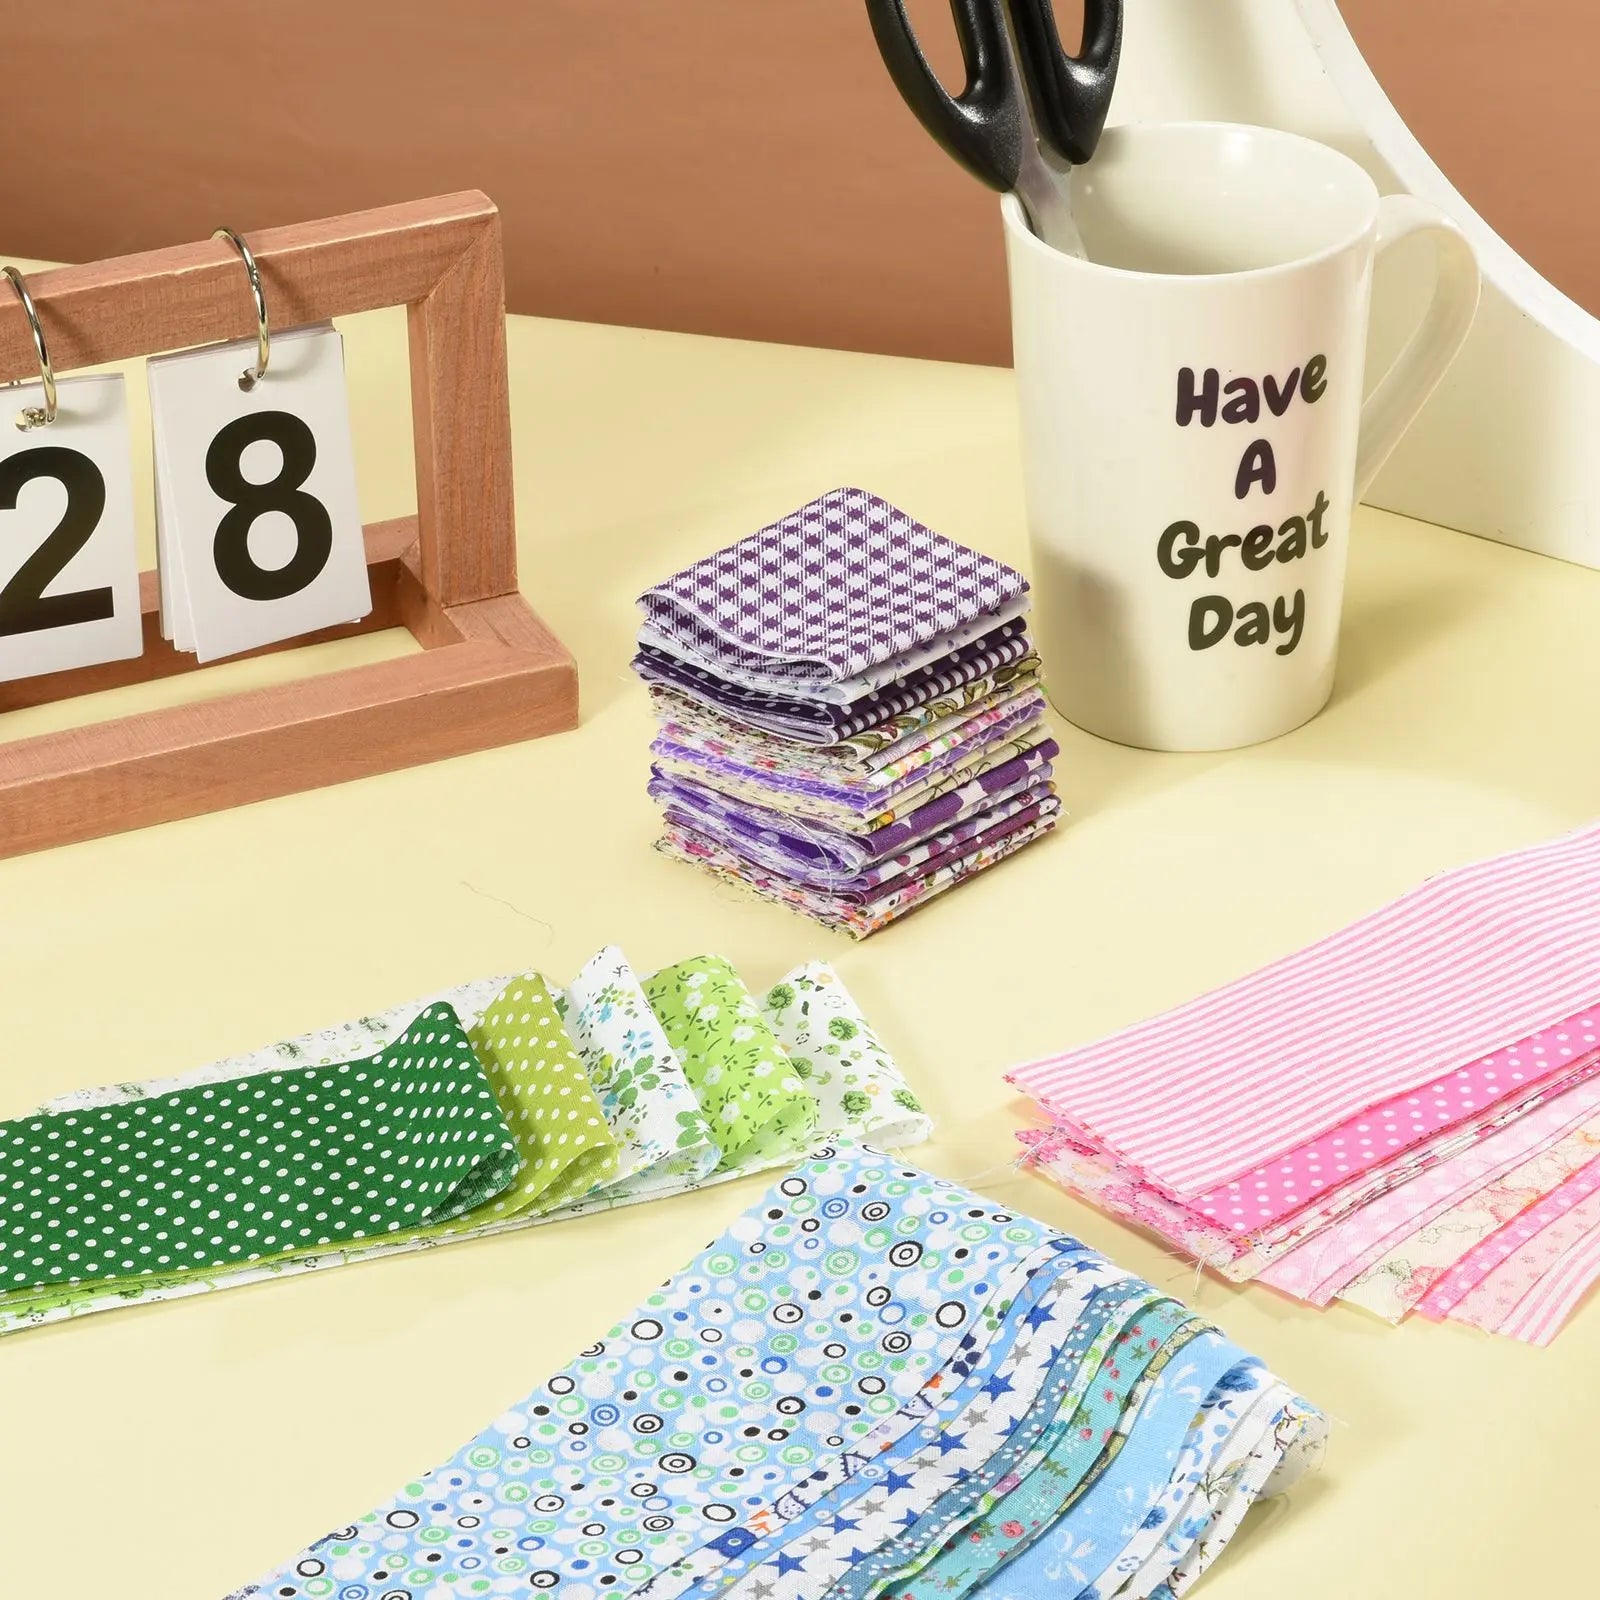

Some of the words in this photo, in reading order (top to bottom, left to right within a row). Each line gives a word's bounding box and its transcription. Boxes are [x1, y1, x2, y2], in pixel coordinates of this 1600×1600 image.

[1175, 353, 1328, 428] Have
[1234, 438, 1277, 500] A
[0, 446, 114, 637] 2
[205, 410, 333, 601] 8
[1156, 490, 1330, 580] Great
[1188, 588, 1306, 656] Day
